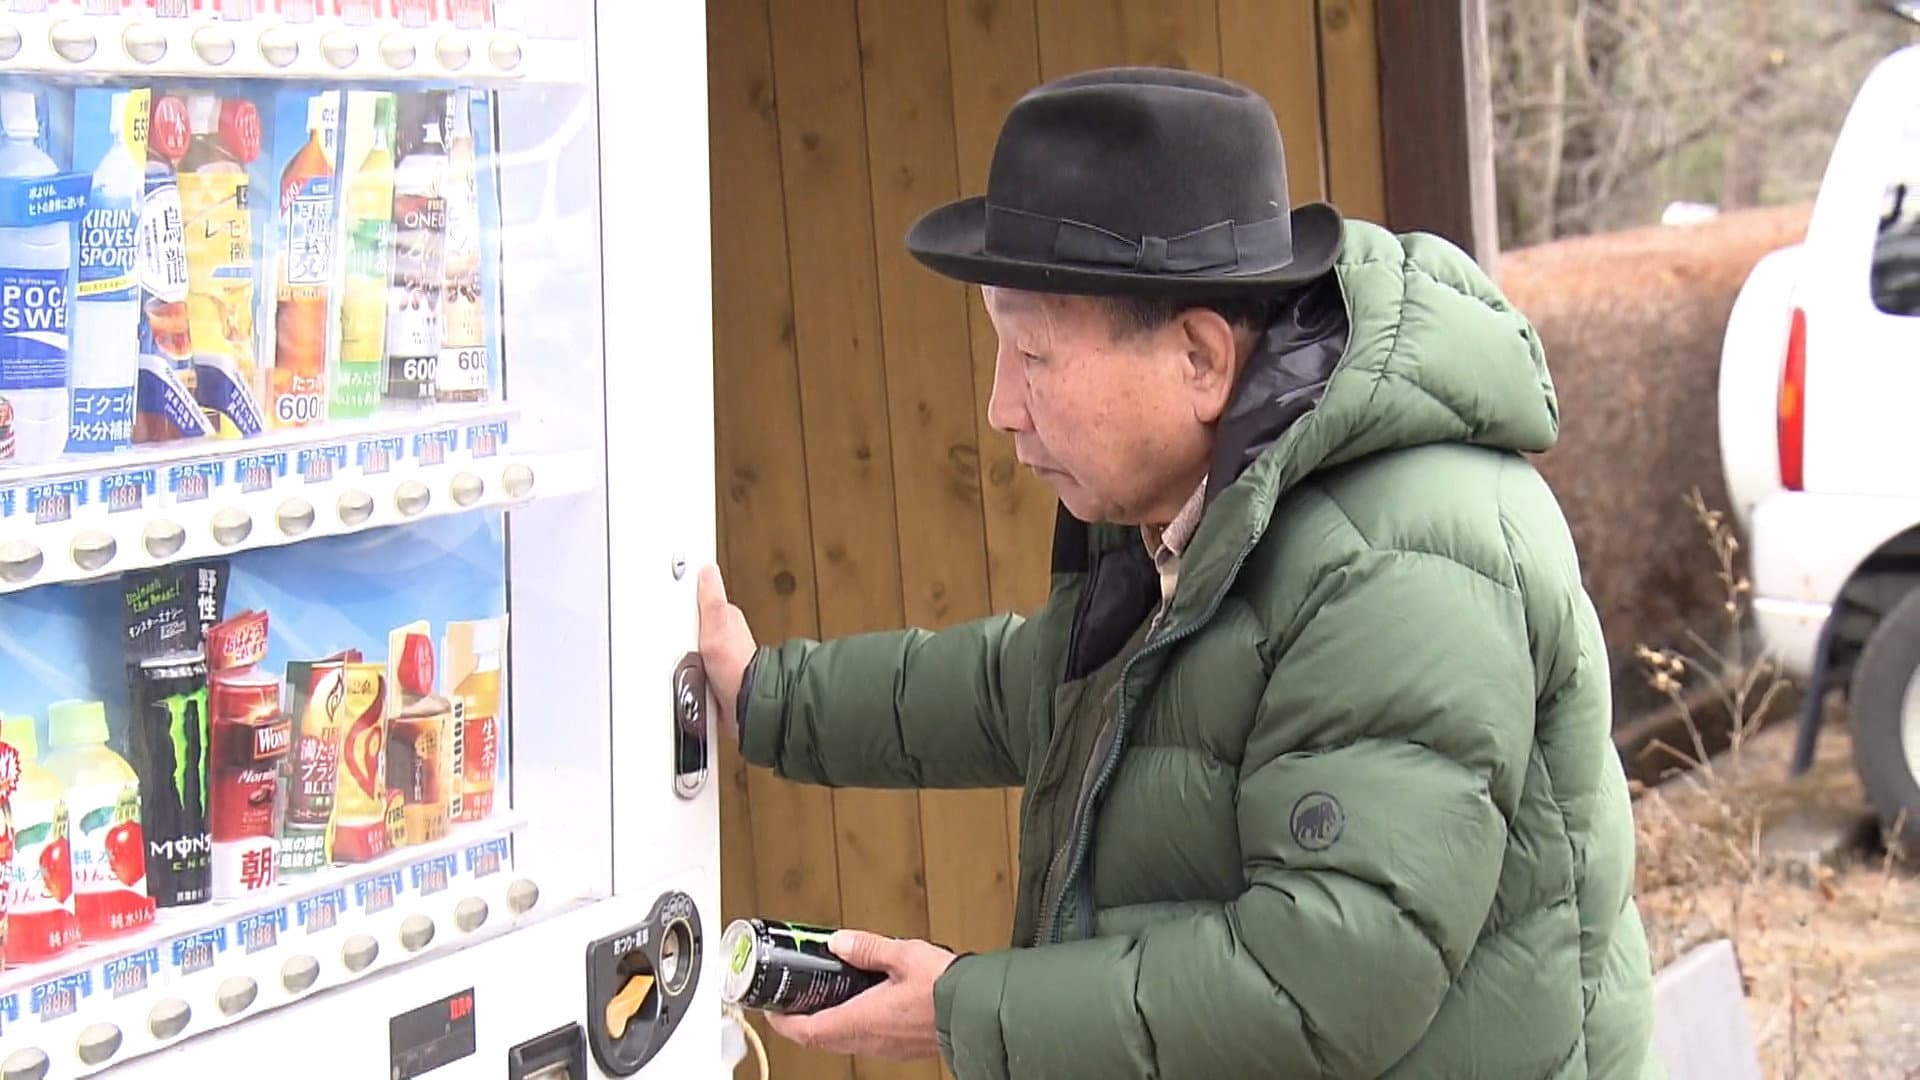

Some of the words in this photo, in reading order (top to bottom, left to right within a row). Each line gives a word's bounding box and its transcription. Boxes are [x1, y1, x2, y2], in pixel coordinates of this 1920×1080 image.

[82, 209, 131, 229] KIRIN
[81, 228, 133, 247] LOVES
[403, 358, 437, 379] 600
[240, 847, 271, 891] 朝
[110, 908, 156, 930] 純水りん
